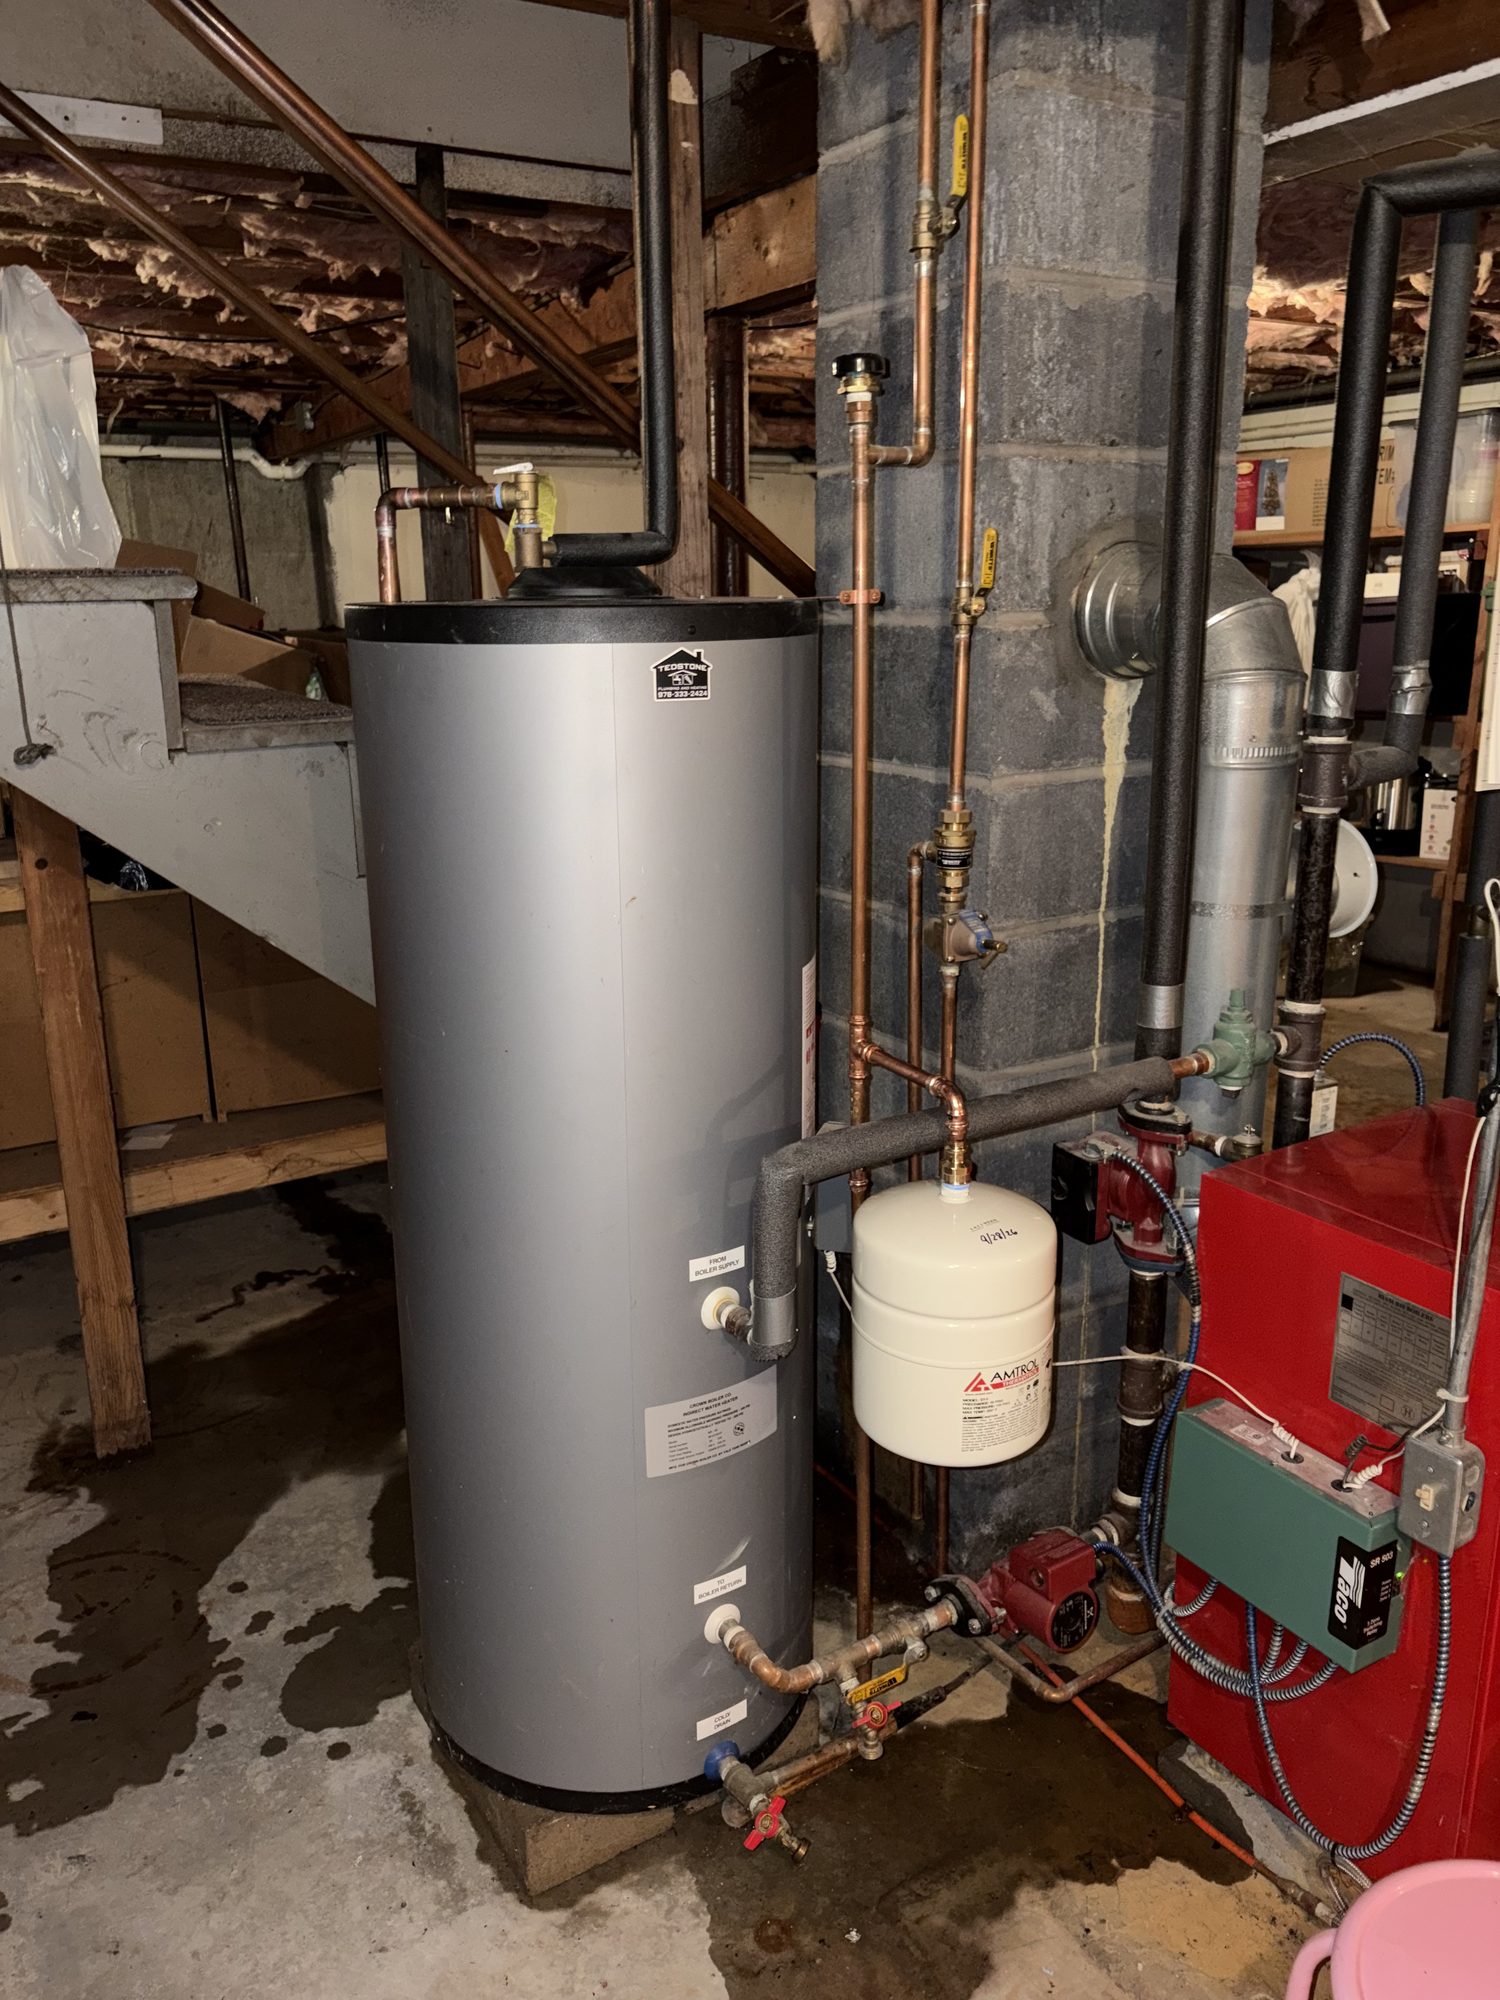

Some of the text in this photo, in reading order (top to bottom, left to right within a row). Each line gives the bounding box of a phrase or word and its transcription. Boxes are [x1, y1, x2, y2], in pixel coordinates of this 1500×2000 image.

[657, 663, 708, 672] TEDSTONE
[657, 690, 708, 698] 978-333-2424
[695, 1258, 740, 1276] BOILER SUPPLY
[709, 1255, 727, 1265] FROM
[990, 1358, 1040, 1383] AMTROL
[1370, 1550, 1394, 1569] SR 503
[698, 1577, 743, 1599] BOILER RETURN
[1334, 1555, 1366, 1624] Taco
[714, 1718, 731, 1730] DRAIN
